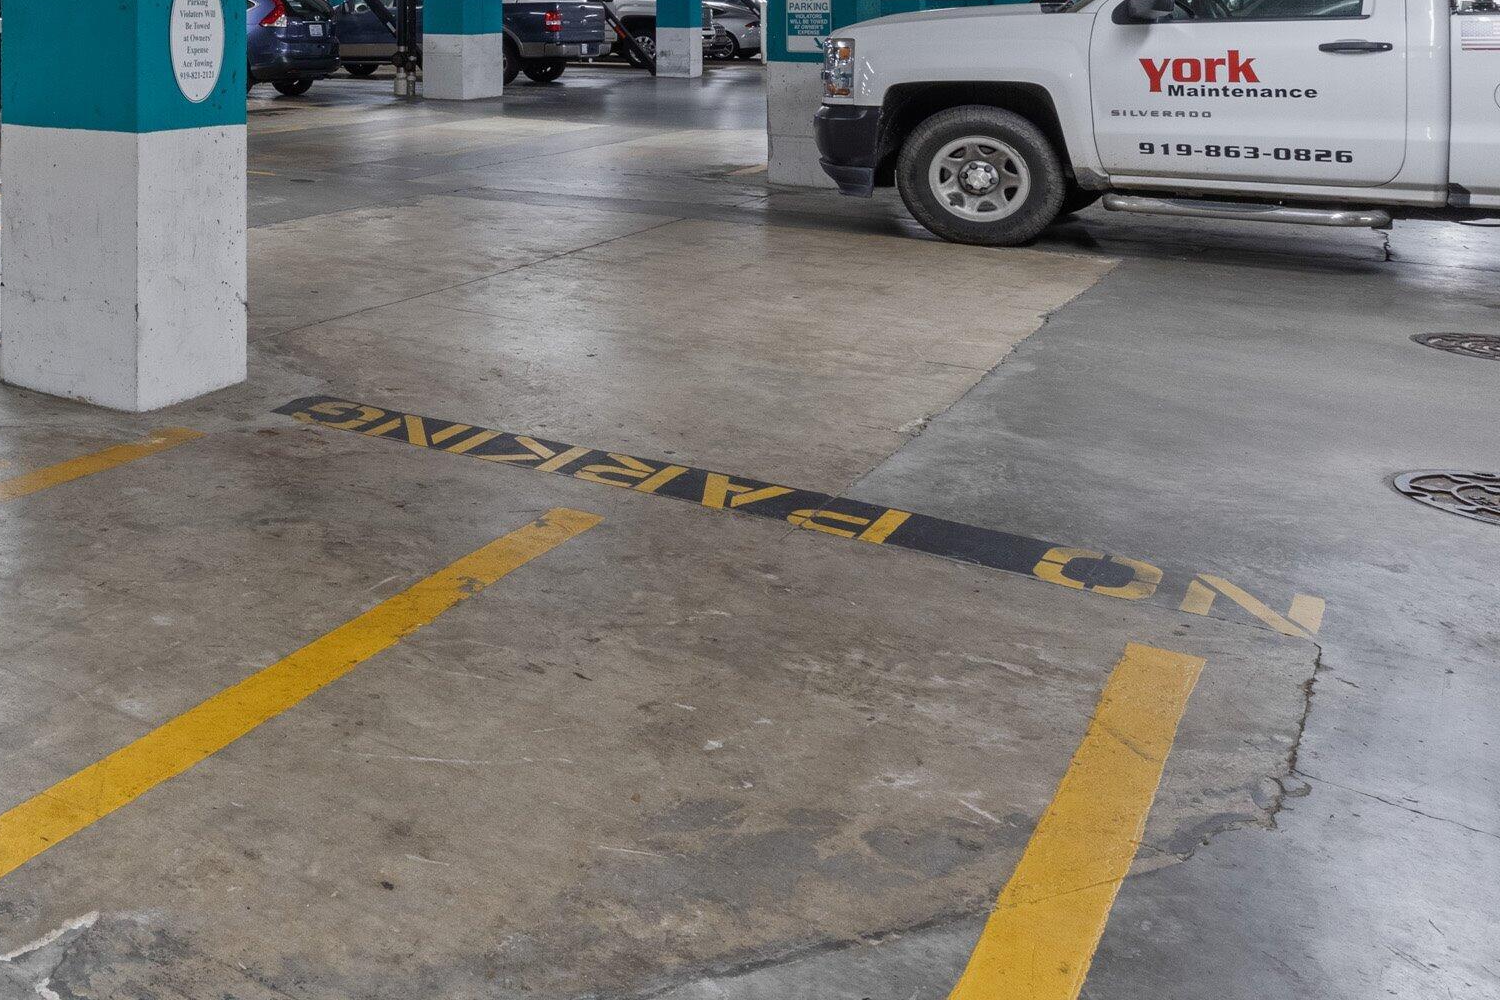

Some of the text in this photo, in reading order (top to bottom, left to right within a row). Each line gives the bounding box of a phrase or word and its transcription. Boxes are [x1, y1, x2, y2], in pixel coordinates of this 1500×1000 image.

[789, 2, 829, 11] PARKING
[204, 9, 216, 18] Will
[185, 22, 211, 30] Be Towed
[183, 34, 190, 42] at
[186, 46, 209, 57] Expense
[193, 59, 213, 68] Towing
[1167, 85, 1319, 99] Maintenance
[1111, 109, 1212, 119] SILVERADO
[1138, 142, 1353, 164] 919-863-0826
[291, 400, 1326, 637] NO PARKING
